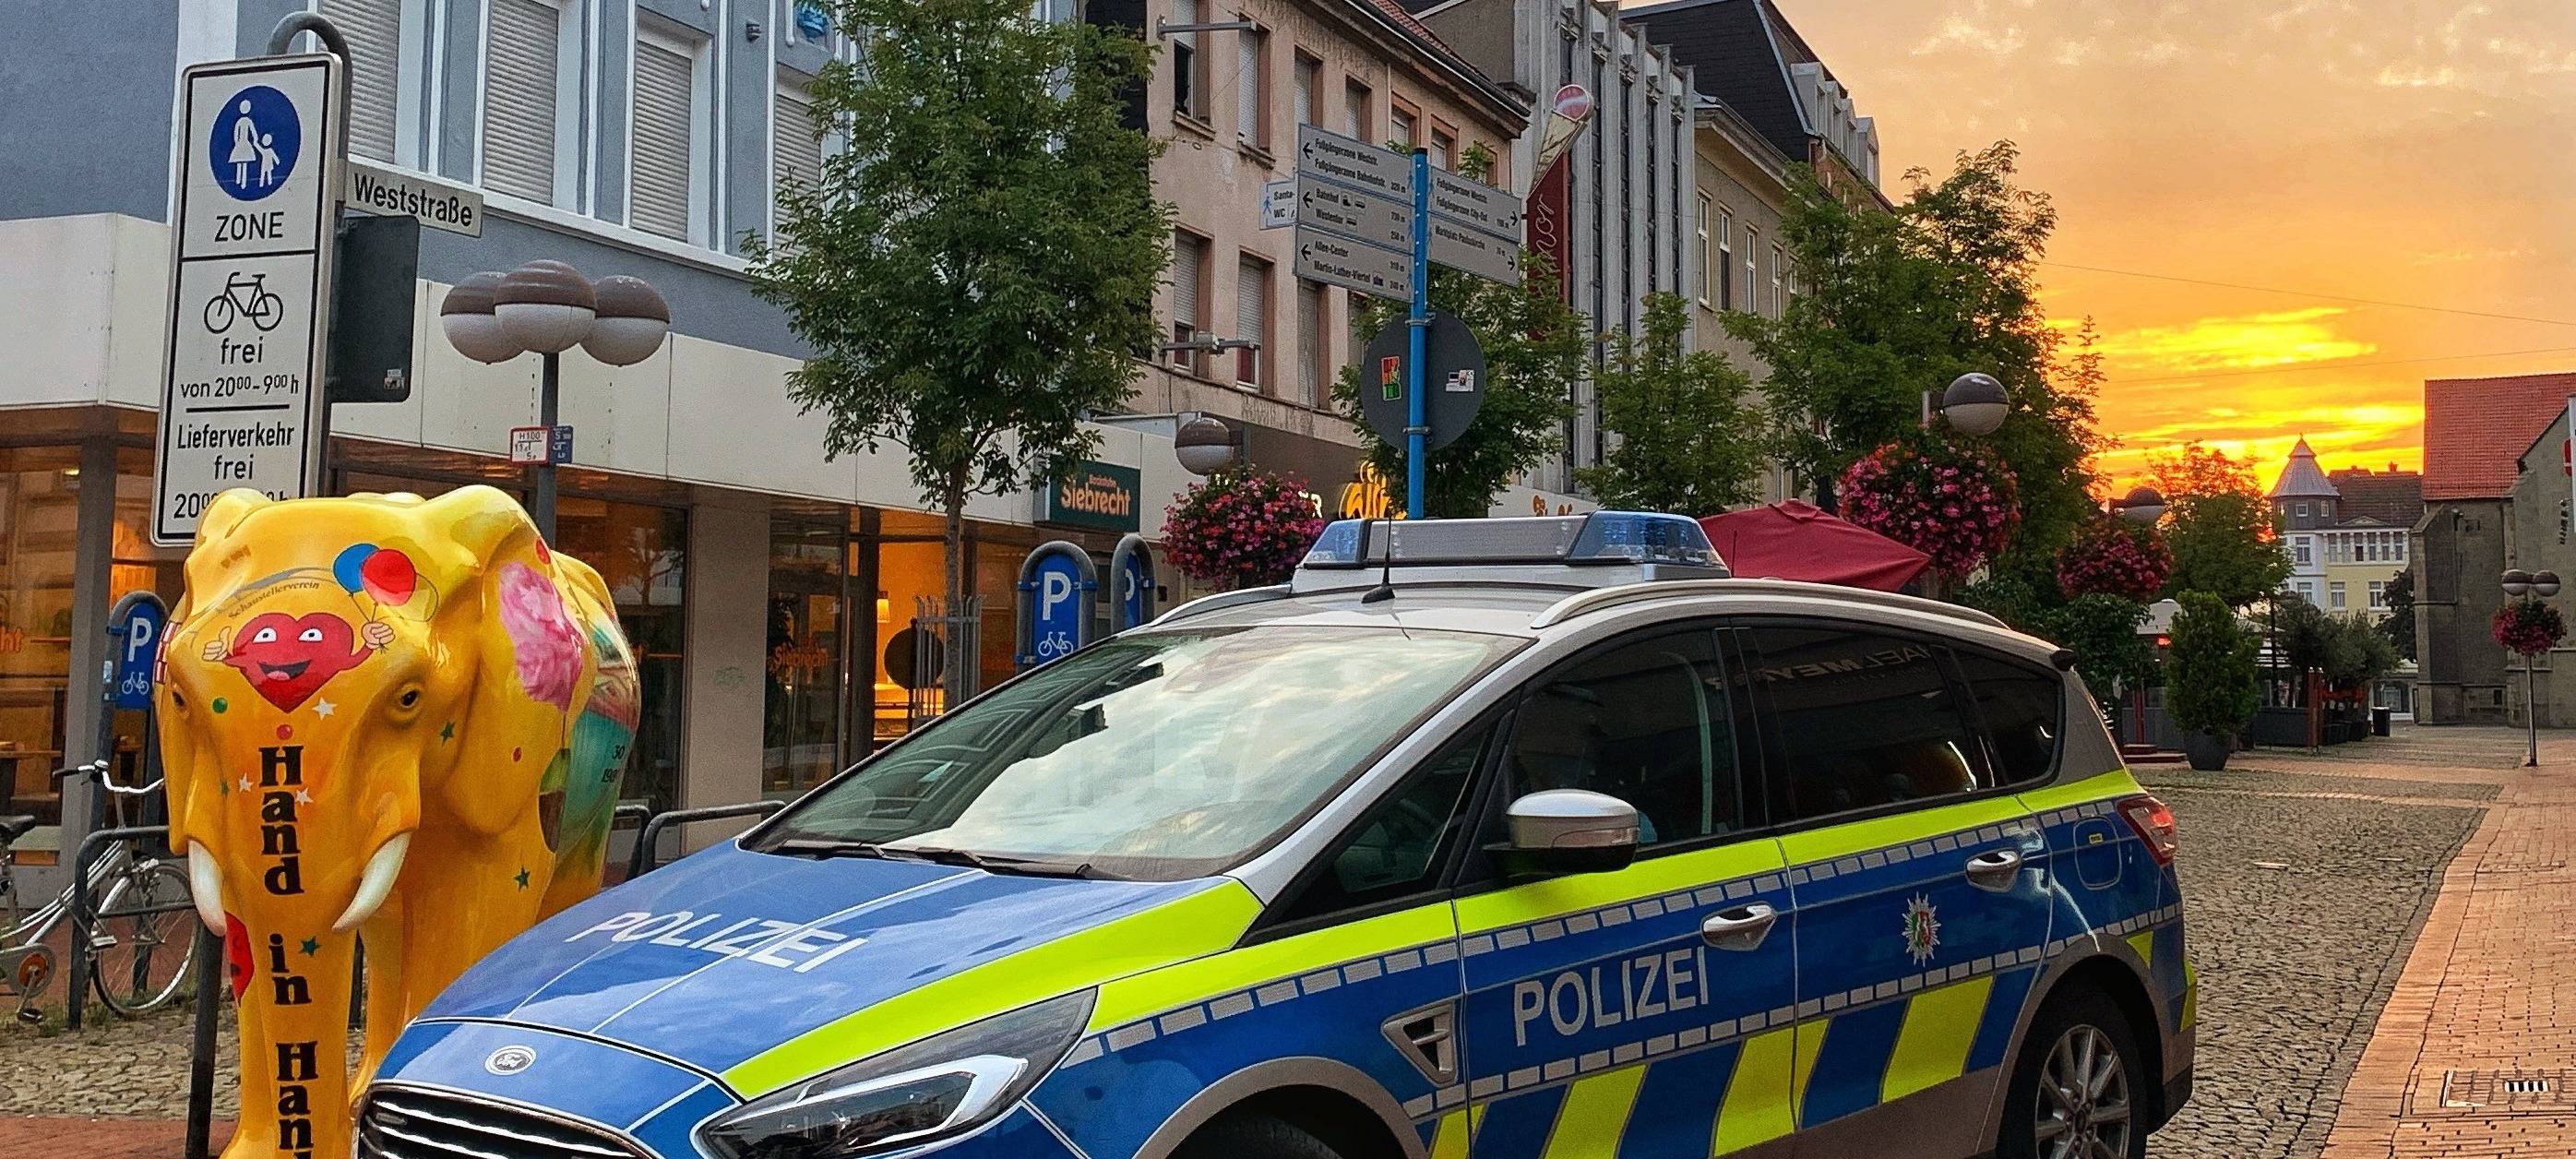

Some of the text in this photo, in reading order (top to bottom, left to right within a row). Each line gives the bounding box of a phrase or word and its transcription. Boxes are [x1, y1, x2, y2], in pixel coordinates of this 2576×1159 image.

[354, 173, 472, 227] Weststraße
[1273, 209, 1286, 218] WC
[214, 211, 284, 242] ZONE
[221, 336, 264, 364] frei
[181, 382, 210, 399] von
[291, 374, 299, 394] h
[177, 421, 294, 448] Lieferverkehr
[214, 454, 255, 480] frei
[1061, 480, 1130, 517] Siebrecht
[229, 581, 320, 618] Schaustellerverein
[1043, 571, 1071, 620] P
[127, 616, 152, 662] P
[612, 745, 626, 759] 30
[258, 746, 319, 1159] Hand in Han
[563, 912, 868, 973] POLIZEI
[1513, 946, 1709, 1046] POLIZEI
